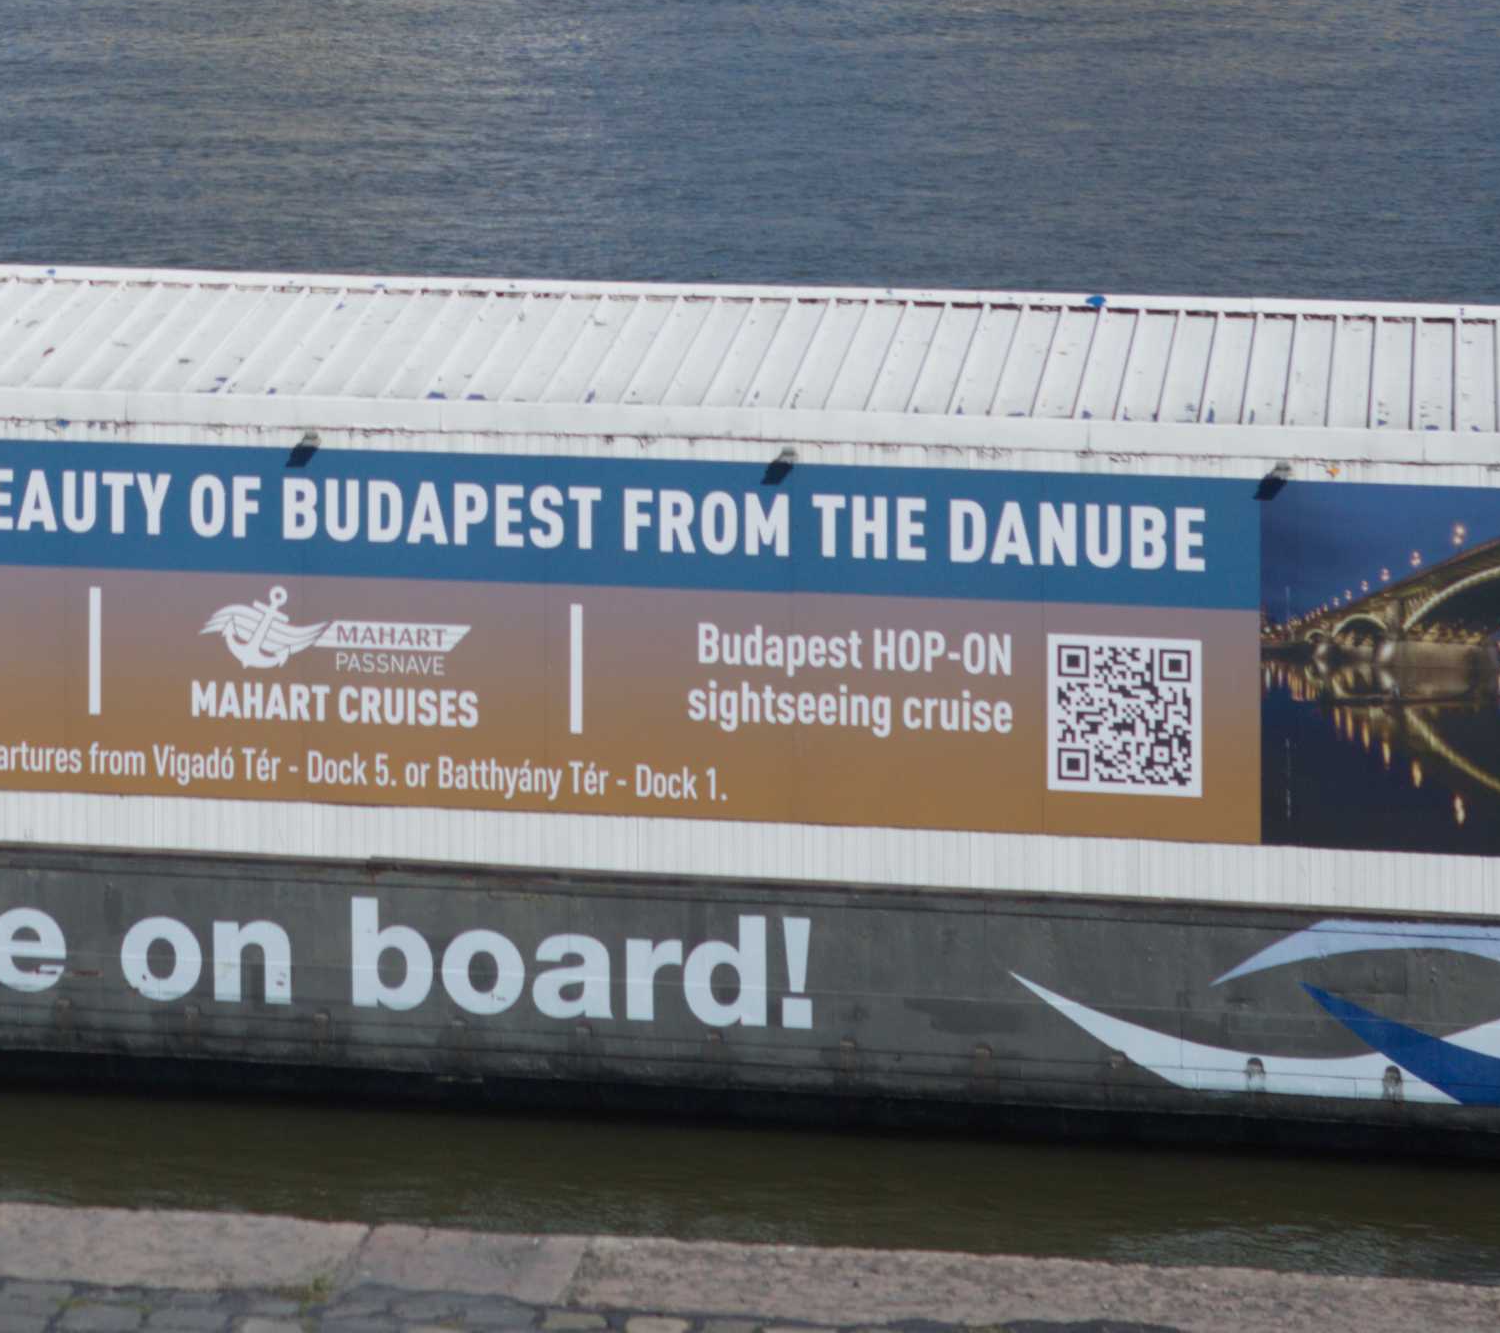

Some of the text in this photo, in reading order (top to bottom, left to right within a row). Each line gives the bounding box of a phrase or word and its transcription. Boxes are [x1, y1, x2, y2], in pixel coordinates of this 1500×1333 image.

[189, 474, 261, 539] OF
[282, 477, 602, 550] BUDAPEST
[623, 488, 790, 557] FROM
[811, 494, 927, 561] THE
[949, 500, 1206, 572] DANUBE
[335, 625, 447, 649] MAHART
[335, 652, 446, 677] PASSNAVE
[698, 622, 1012, 677] Budapest HOP-ON
[191, 680, 479, 728] MAHART CRUISES
[687, 679, 1013, 738] sightseeing cruise
[88, 742, 146, 776] from
[152, 744, 235, 786] Vigadó
[241, 747, 281, 782] Tér
[307, 749, 367, 785] Dock
[375, 752, 397, 787] 5.
[404, 762, 431, 788] or
[438, 755, 563, 801] Batthyány
[568, 760, 609, 795] Tér
[635, 763, 698, 800] Dock
[707, 767, 728, 801] 1.
[119, 915, 292, 1004] on
[351, 896, 813, 1029] board!
